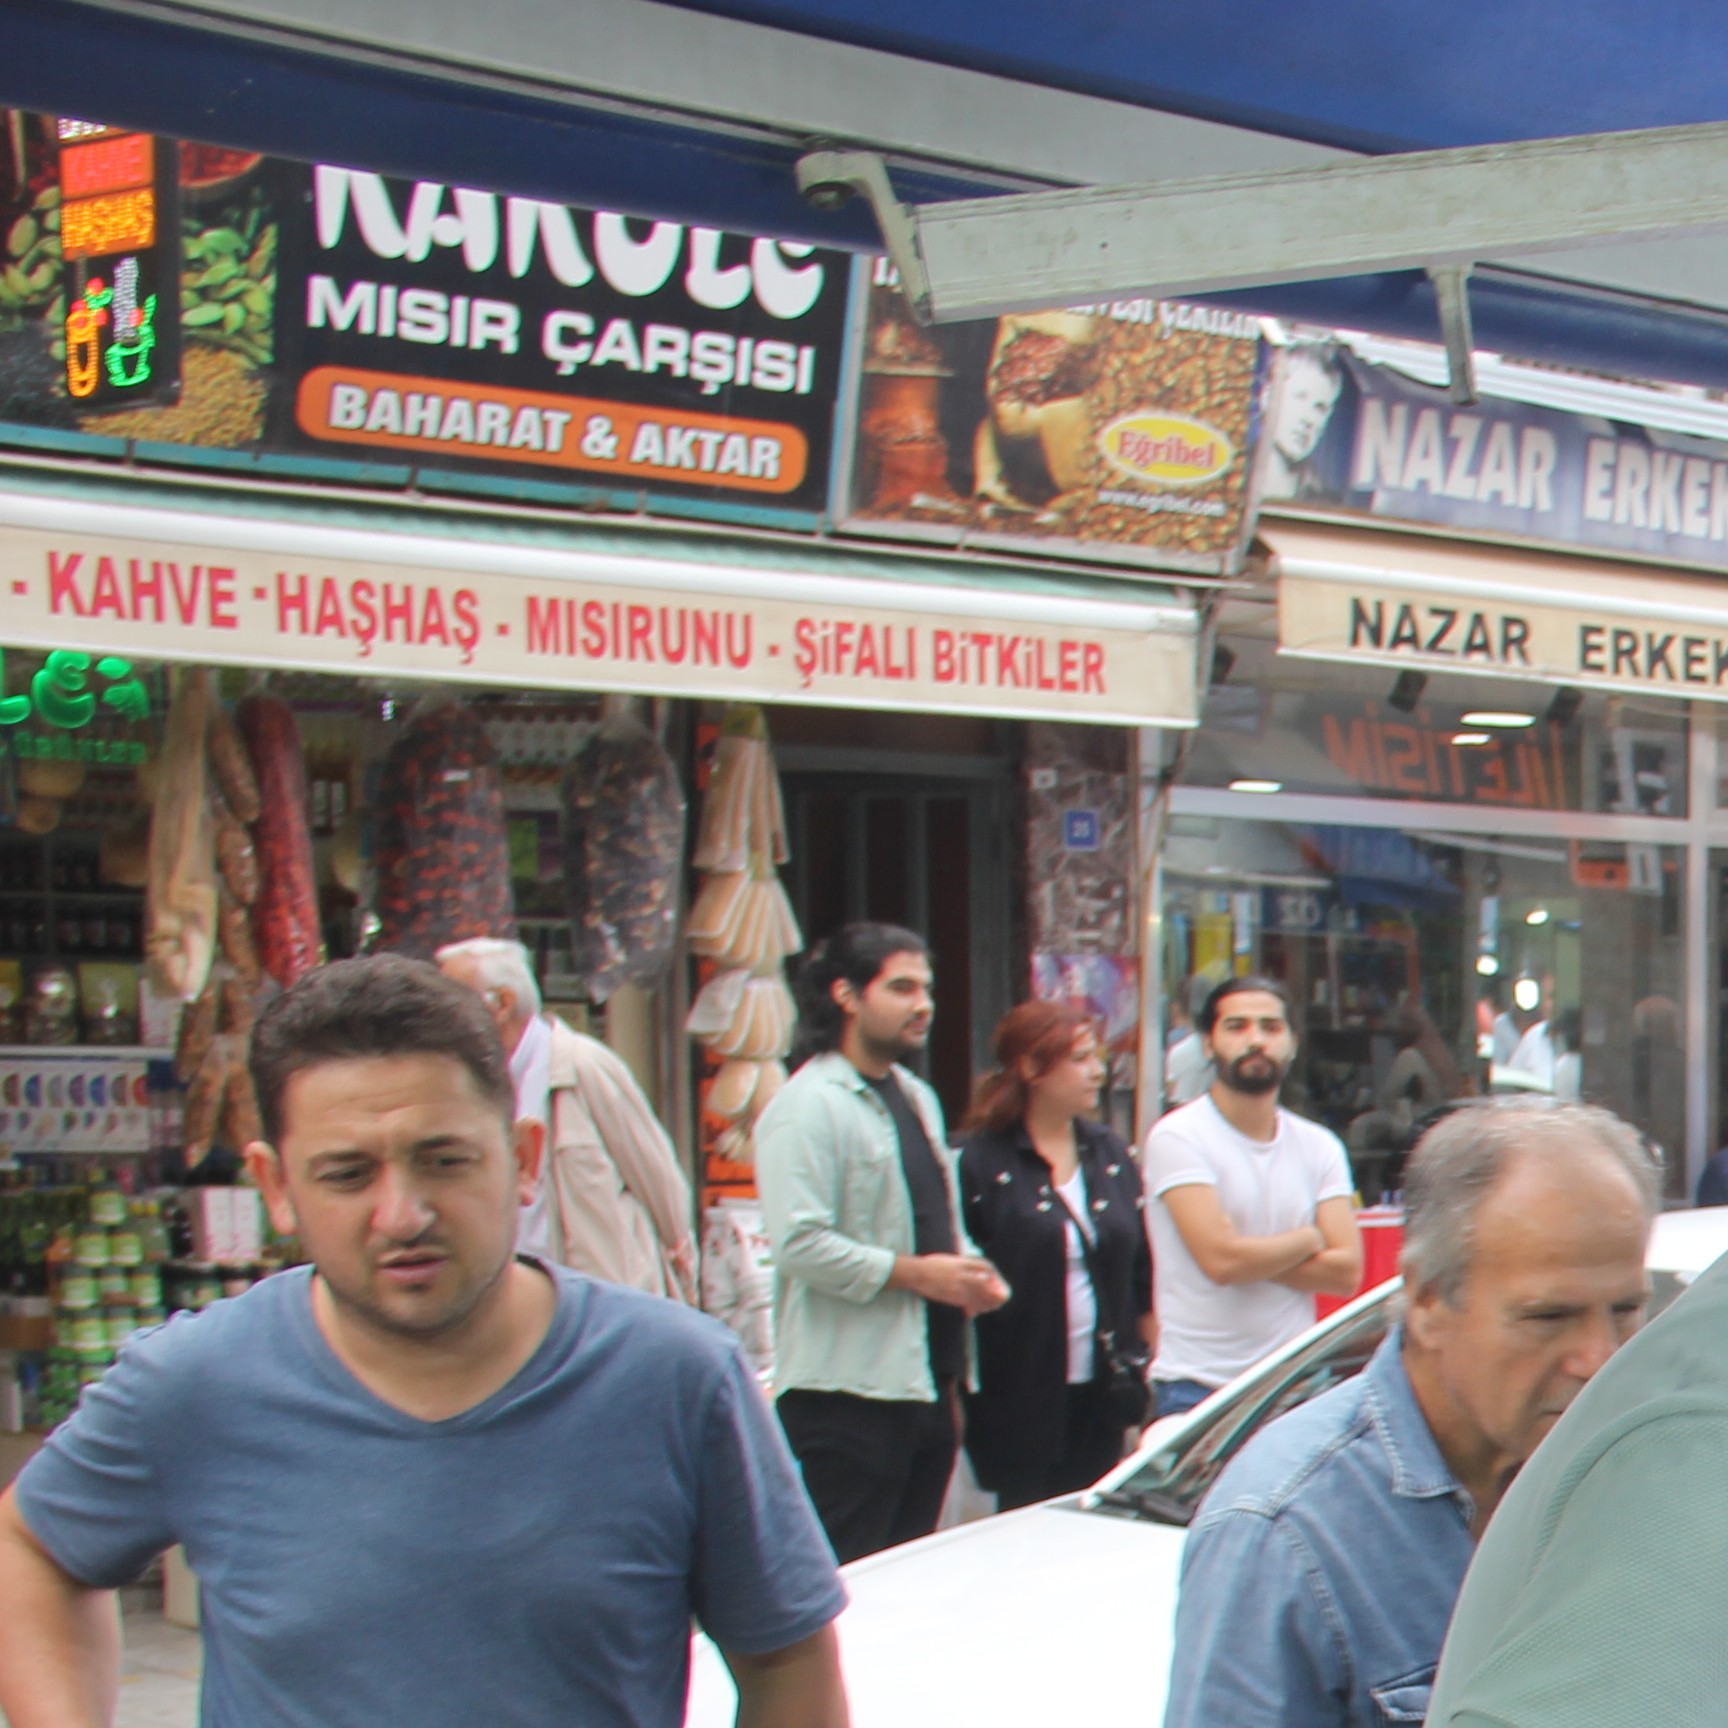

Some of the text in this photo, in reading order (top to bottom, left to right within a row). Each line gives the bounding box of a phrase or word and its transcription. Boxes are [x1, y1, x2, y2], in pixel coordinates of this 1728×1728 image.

[307, 275, 815, 395] MISIR ÇARŞISI
[328, 383, 782, 479] BAHARAT & AKTAR
[1119, 430, 1216, 469] Eğribel
[1354, 399, 1558, 514] NAZAR
[47, 550, 239, 629] KAHVE
[277, 571, 481, 664] HAŞHAŞ
[526, 597, 753, 669] MISIRUNU
[1348, 598, 1534, 666] NAZAR
